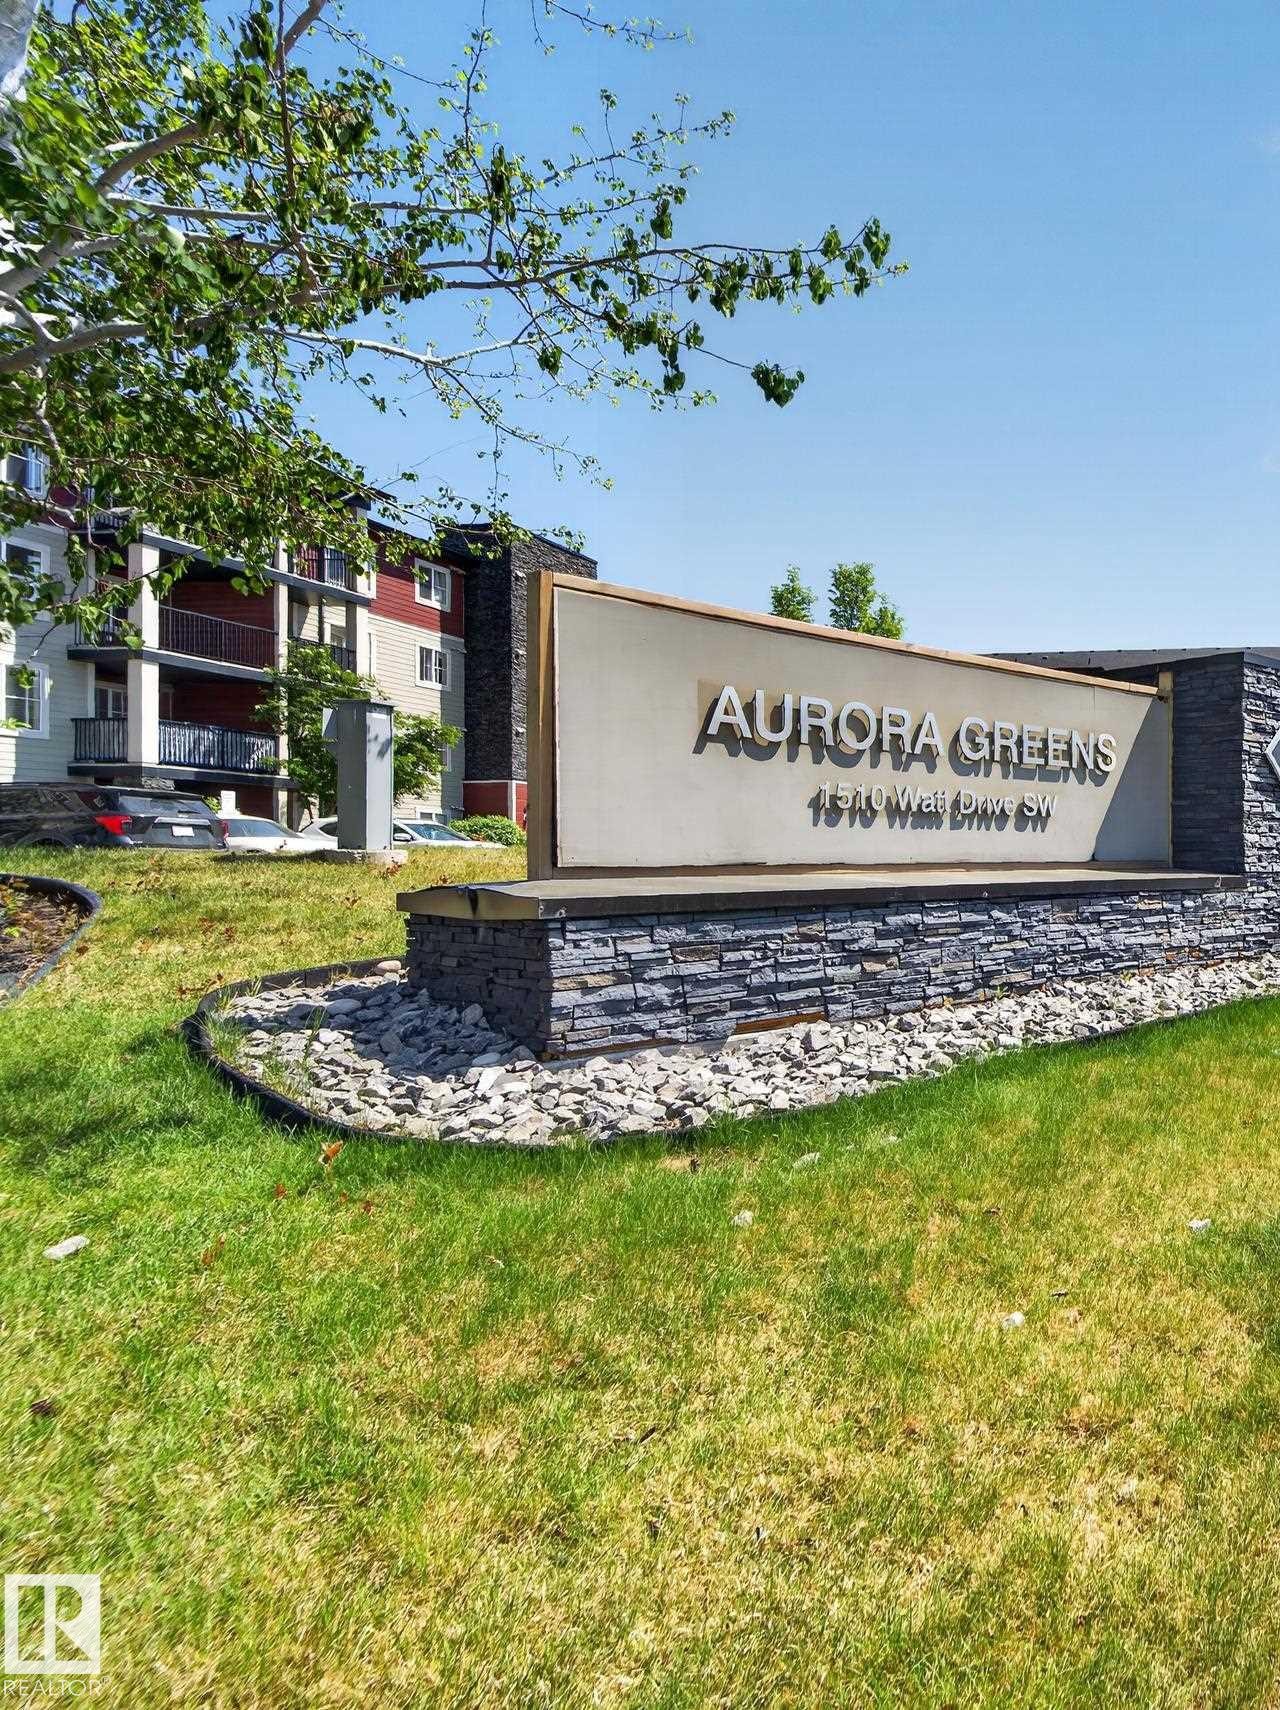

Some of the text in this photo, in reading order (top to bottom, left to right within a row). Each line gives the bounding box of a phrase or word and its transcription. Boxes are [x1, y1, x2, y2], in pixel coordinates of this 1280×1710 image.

[706, 685, 1117, 772] AURORA GREENS
[818, 782, 887, 811] 1510
[959, 788, 1015, 816] Drive
[1023, 791, 1057, 817] SW
